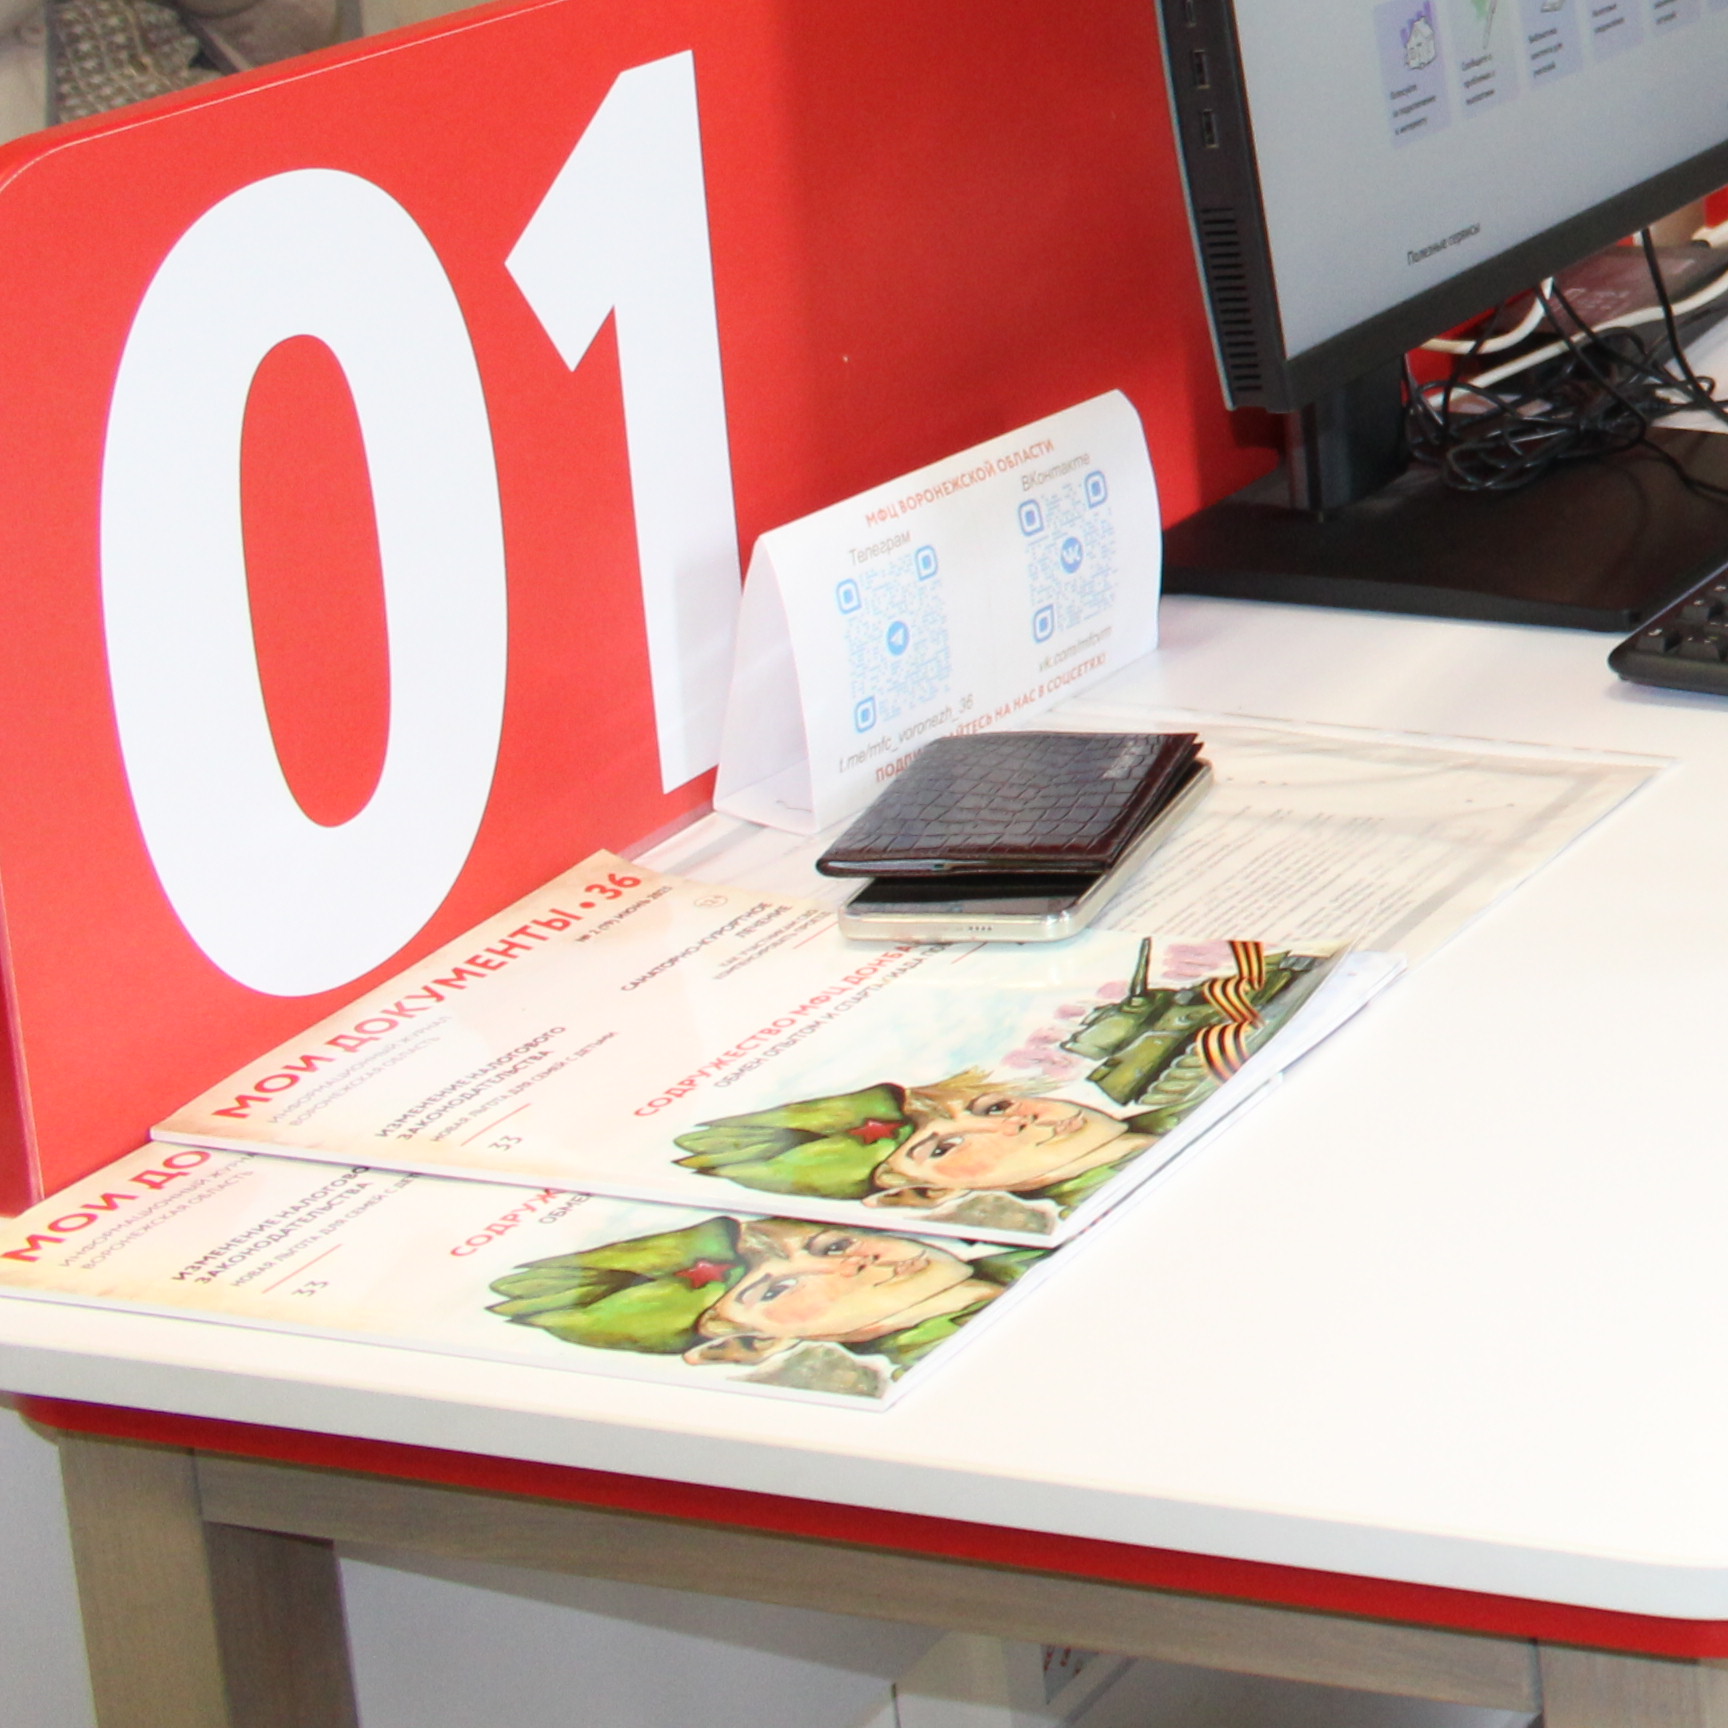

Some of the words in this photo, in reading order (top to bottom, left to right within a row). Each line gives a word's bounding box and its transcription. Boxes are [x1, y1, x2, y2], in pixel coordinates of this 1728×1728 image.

[1407, 231, 1451, 268] Полезные
[1448, 221, 1482, 253] сервисы
[865, 501, 898, 529] МФЦ
[897, 460, 998, 514] ВОРОНЕЖСКОЙ
[996, 437, 1056, 475] ОБЛАСТИ
[1020, 451, 1092, 492] ВКонтакте
[99, 48, 744, 997] 01
[848, 529, 912, 566] Телеграм
[875, 711, 994, 783] ПОДПИЙТЕСЬ
[994, 703, 1013, 724] НА
[1012, 687, 1037, 712] НАС
[620, 901, 770, 993] САНАТОРНО-КУРОРТНОЕ
[735, 904, 793, 939] ЛЕЧЕНИЕ
[211, 1053, 336, 1120] МОИ
[326, 908, 584, 1054] ДОКУМЕНТЫ
[584, 872, 643, 902] 36
[713, 1055, 767, 1090] ОБМЕН
[760, 1017, 829, 1062] ОПЫТОМ
[832, 951, 926, 1015] СПАРТАКИАДА
[266, 1040, 402, 1125] ИНФОРМАЦИОННЫЙ
[398, 1014, 454, 1048] ЖУРНАЛ
[287, 1063, 387, 1128] ВОРОНЕЖСКАЯ
[383, 1035, 443, 1073] ОБЛАСТЬ
[375, 1075, 471, 1140] ИЗМЕНЕНИЕ
[468, 1025, 568, 1083] НАЛОГОВОГО
[396, 1049, 555, 1142] ЗАКОНОДАТЕЛЬСТВА
[428, 1112, 472, 1144] НОВАЯ
[468, 1089, 514, 1122] ЛЬГОТА
[507, 1077, 535, 1099] ДЛЯ
[531, 1060, 568, 1088] СЕМЕЙ
[574, 1030, 621, 1063] ДЕТЬМИ
[633, 1016, 799, 1119] СОДРУЖЕСТВО
[797, 983, 846, 1019] МФЦ
[487, 1134, 523, 1152] 33
[0, 1191, 139, 1263] МОИ
[129, 1150, 214, 1191] ДО
[58, 1175, 210, 1269] ИНФОРМАЦИОННЫЙ
[207, 1151, 260, 1185] ЖУРНА
[80, 1199, 191, 1270] ВОРОНЕЖСКАЯ
[188, 1169, 255, 1210] ОБЛАСТЬ
[171, 1207, 285, 1282] ИЗМЕНЕНИЕ
[280, 1164, 372, 1215] НАЛОГОВО
[193, 1181, 373, 1285] ЗАКОНОДАТЕЛЬСТВА
[229, 1254, 277, 1288] НОВАЯ
[275, 1230, 323, 1264] ЛЬГОТА
[320, 1218, 349, 1240] ДЛЯ
[346, 1196, 386, 1226] СЕМЕЙ
[449, 1186, 567, 1258] СОДРУЖ
[291, 1278, 330, 1297] 33
